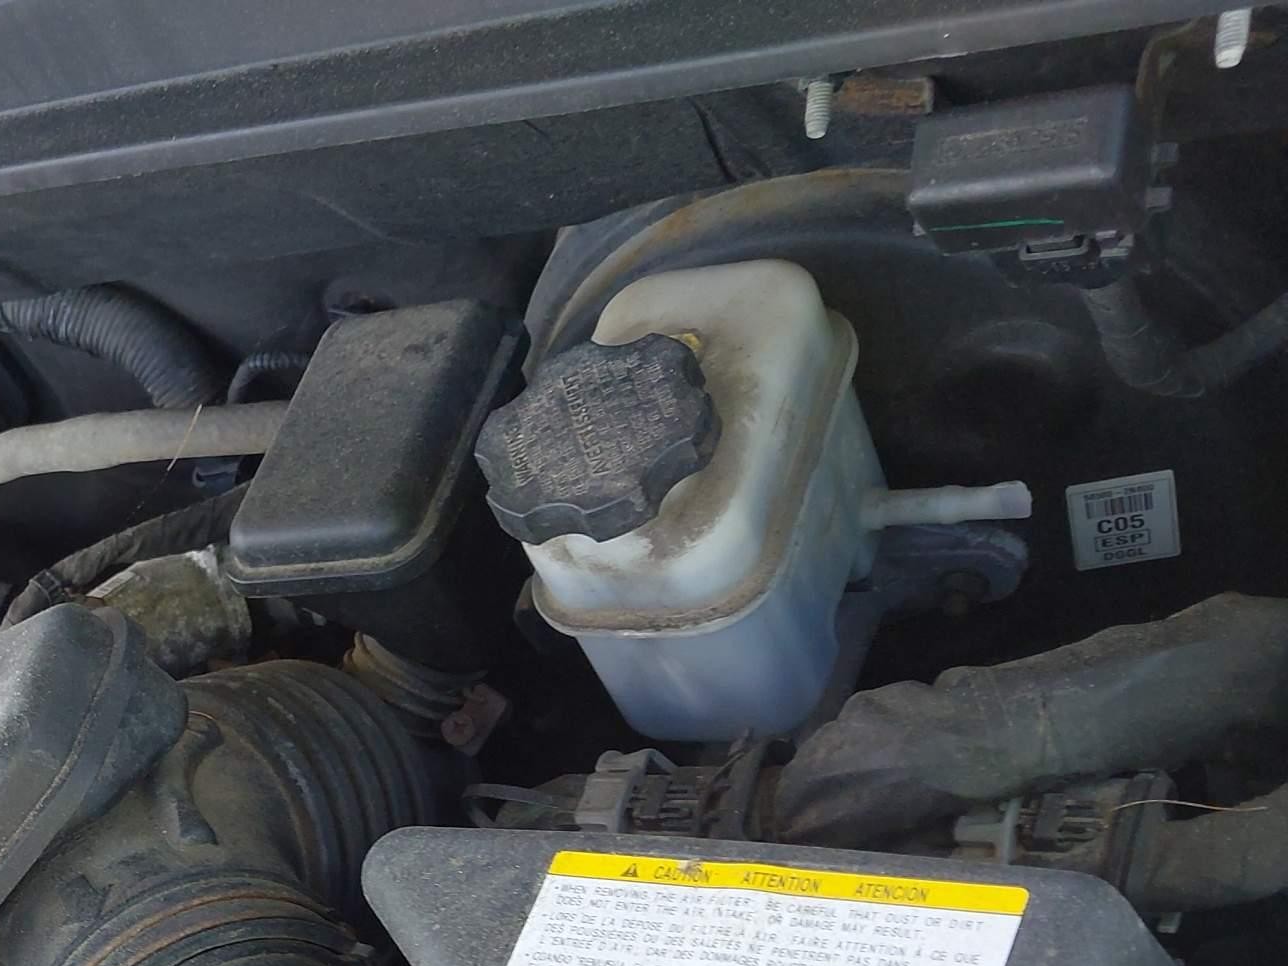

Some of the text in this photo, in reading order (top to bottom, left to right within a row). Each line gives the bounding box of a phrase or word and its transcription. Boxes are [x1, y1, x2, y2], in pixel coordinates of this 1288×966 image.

[1097, 514, 1145, 534] C05
[1101, 533, 1145, 547] ESP
[740, 871, 823, 892] ATTENTION
[556, 895, 583, 905] DOES
[589, 898, 609, 908] NOT
[615, 901, 649, 912] ENTER
[655, 904, 677, 914] THE
[684, 906, 705, 916] AIR
[767, 915, 783, 925] OR
[790, 918, 835, 930] DAMAGE
[841, 923, 865, 933] MAY
[561, 884, 587, 894] WHEN
[594, 887, 648, 899] REMOVING
[655, 892, 676, 902] THE
[681, 894, 703, 904] AIR
[765, 901, 781, 911] BE
[786, 904, 840, 917] CAREFUL
[847, 909, 879, 920] THAT
[884, 913, 918, 924] DUST
[924, 917, 943, 927] OR
[949, 919, 984, 931] DIRT
[545, 923, 564, 933] DES
[644, 934, 658, 944] OU
[665, 935, 686, 946] DES
[746, 944, 764, 954] NE
[846, 955, 871, 966] PAS
[550, 911, 576, 921] LORS
[581, 915, 597, 924] DE
[601, 916, 616, 926] LA
[690, 923, 732, 937] FILTRE
[791, 935, 829, 948] FAIRE
[835, 940, 907, 956] ATTENTION
[929, 950, 948, 960] CE
[954, 953, 981, 964] QUE
[646, 946, 668, 957] CAR
[673, 949, 694, 959] DES
[700, 951, 761, 966] DOMMAGES
